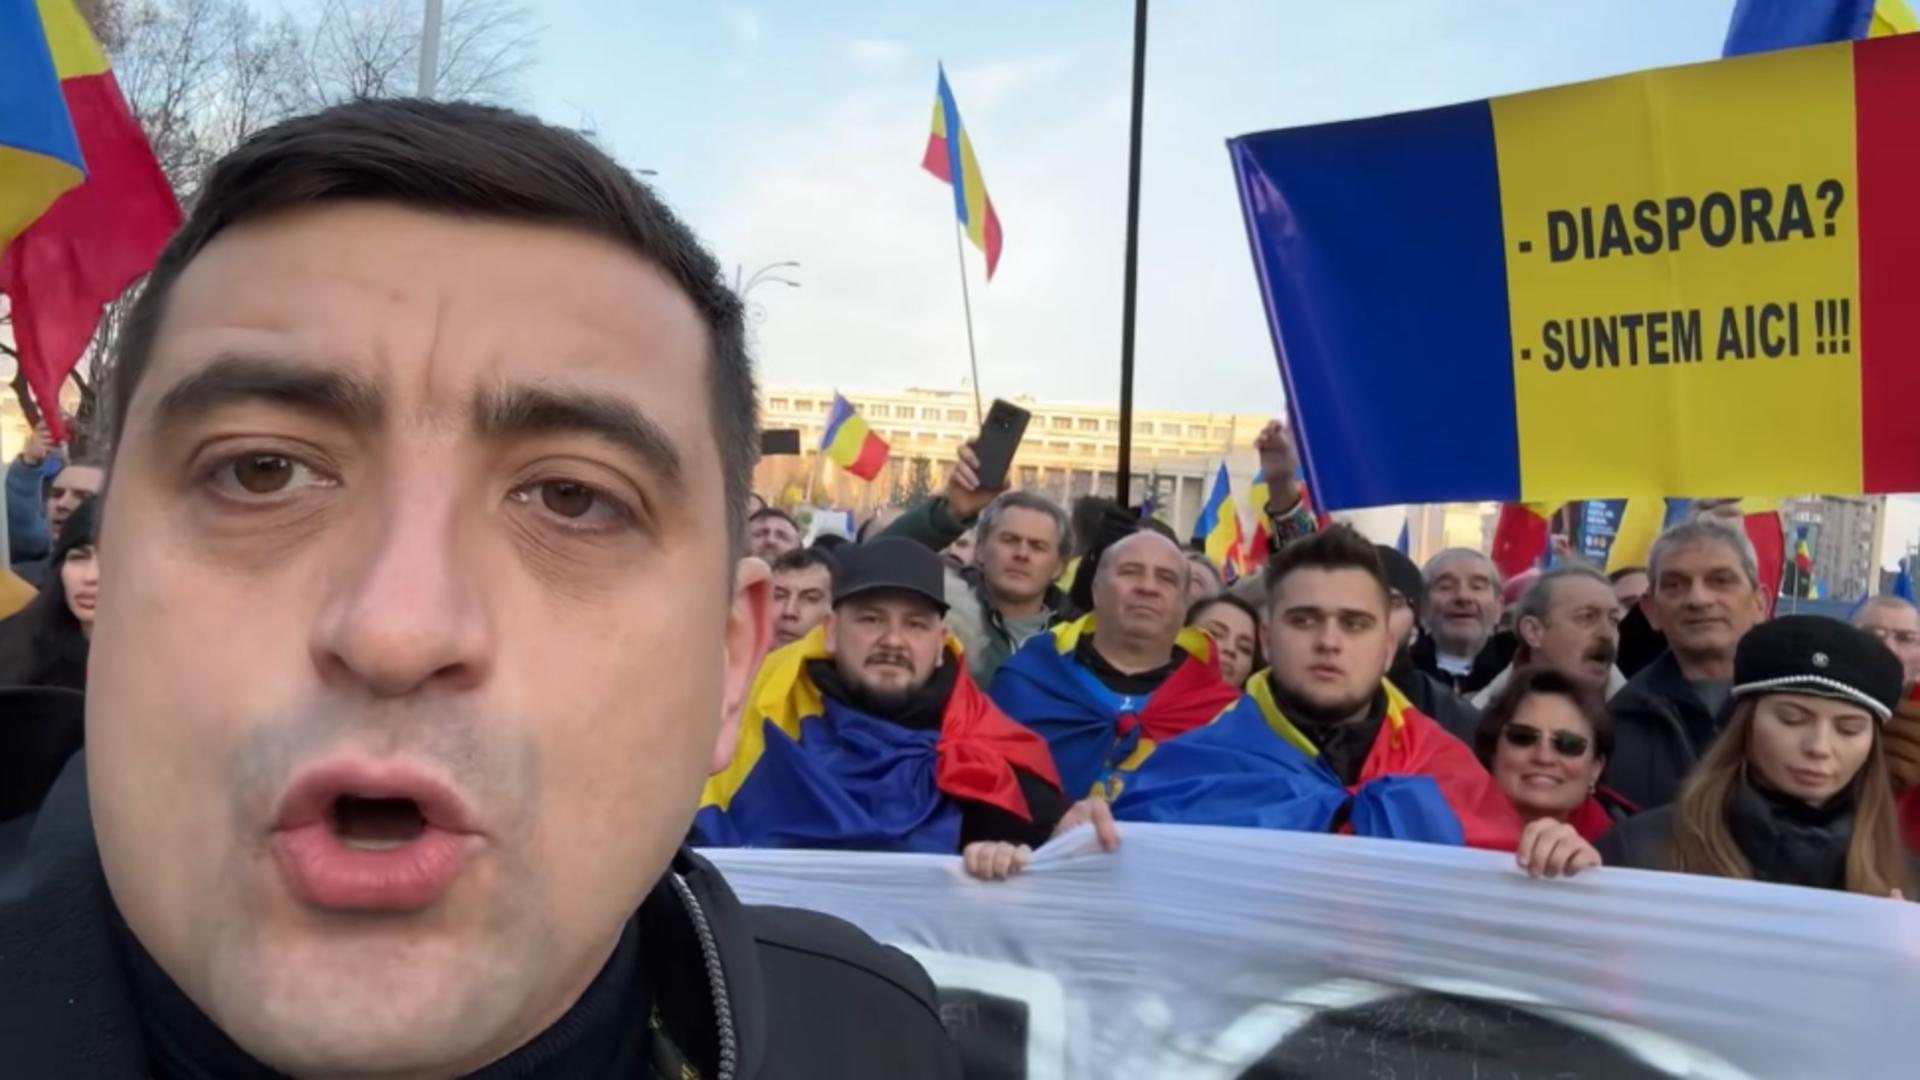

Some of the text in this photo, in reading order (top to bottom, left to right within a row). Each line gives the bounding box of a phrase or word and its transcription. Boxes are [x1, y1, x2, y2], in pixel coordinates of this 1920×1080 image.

[1547, 178, 1845, 263] DIASPORA?
[1542, 309, 1703, 372] SUNTEM
[1716, 302, 1799, 361] AICI
